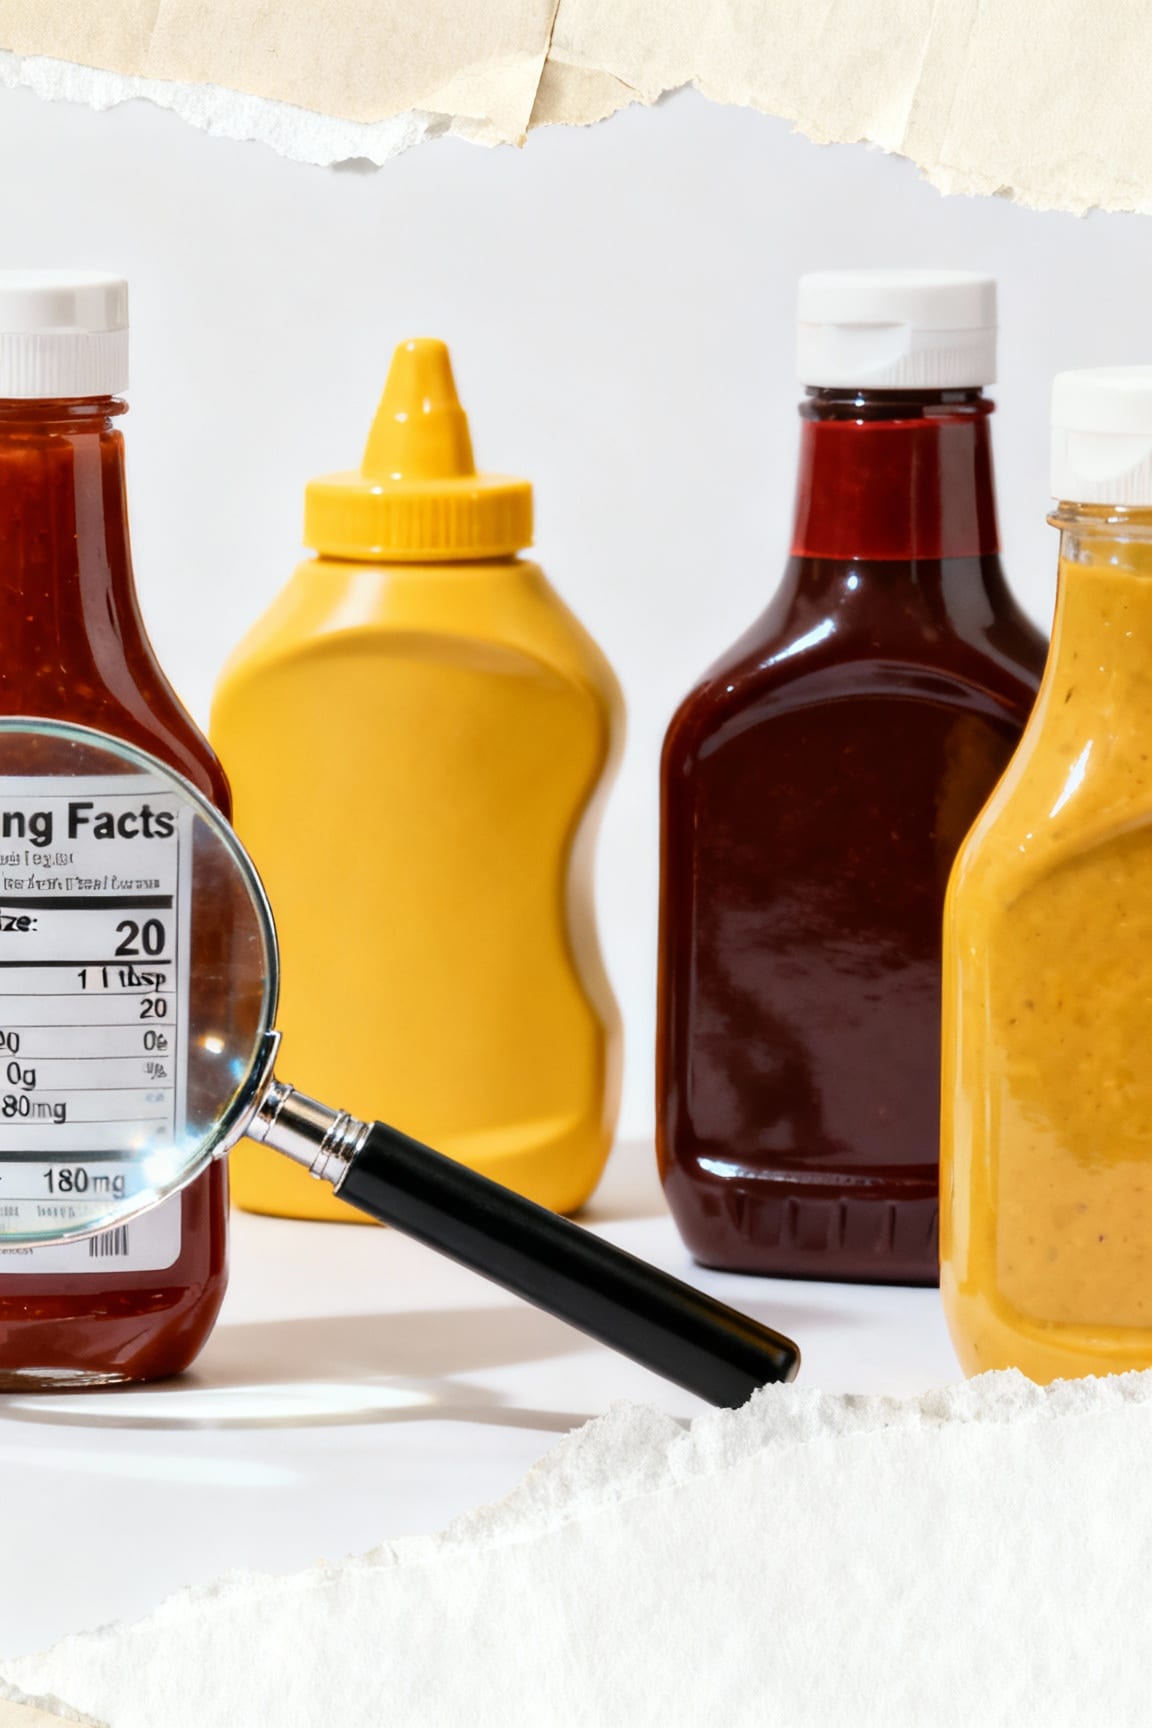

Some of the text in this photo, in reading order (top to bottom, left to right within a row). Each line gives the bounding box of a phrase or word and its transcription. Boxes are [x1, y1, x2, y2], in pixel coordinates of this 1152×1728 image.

[67, 801, 175, 839] Facts
[115, 919, 166, 957] 20
[140, 998, 167, 1019] 20
[7, 1061, 36, 1091] 0g
[43, 1167, 126, 1199] 180mg
